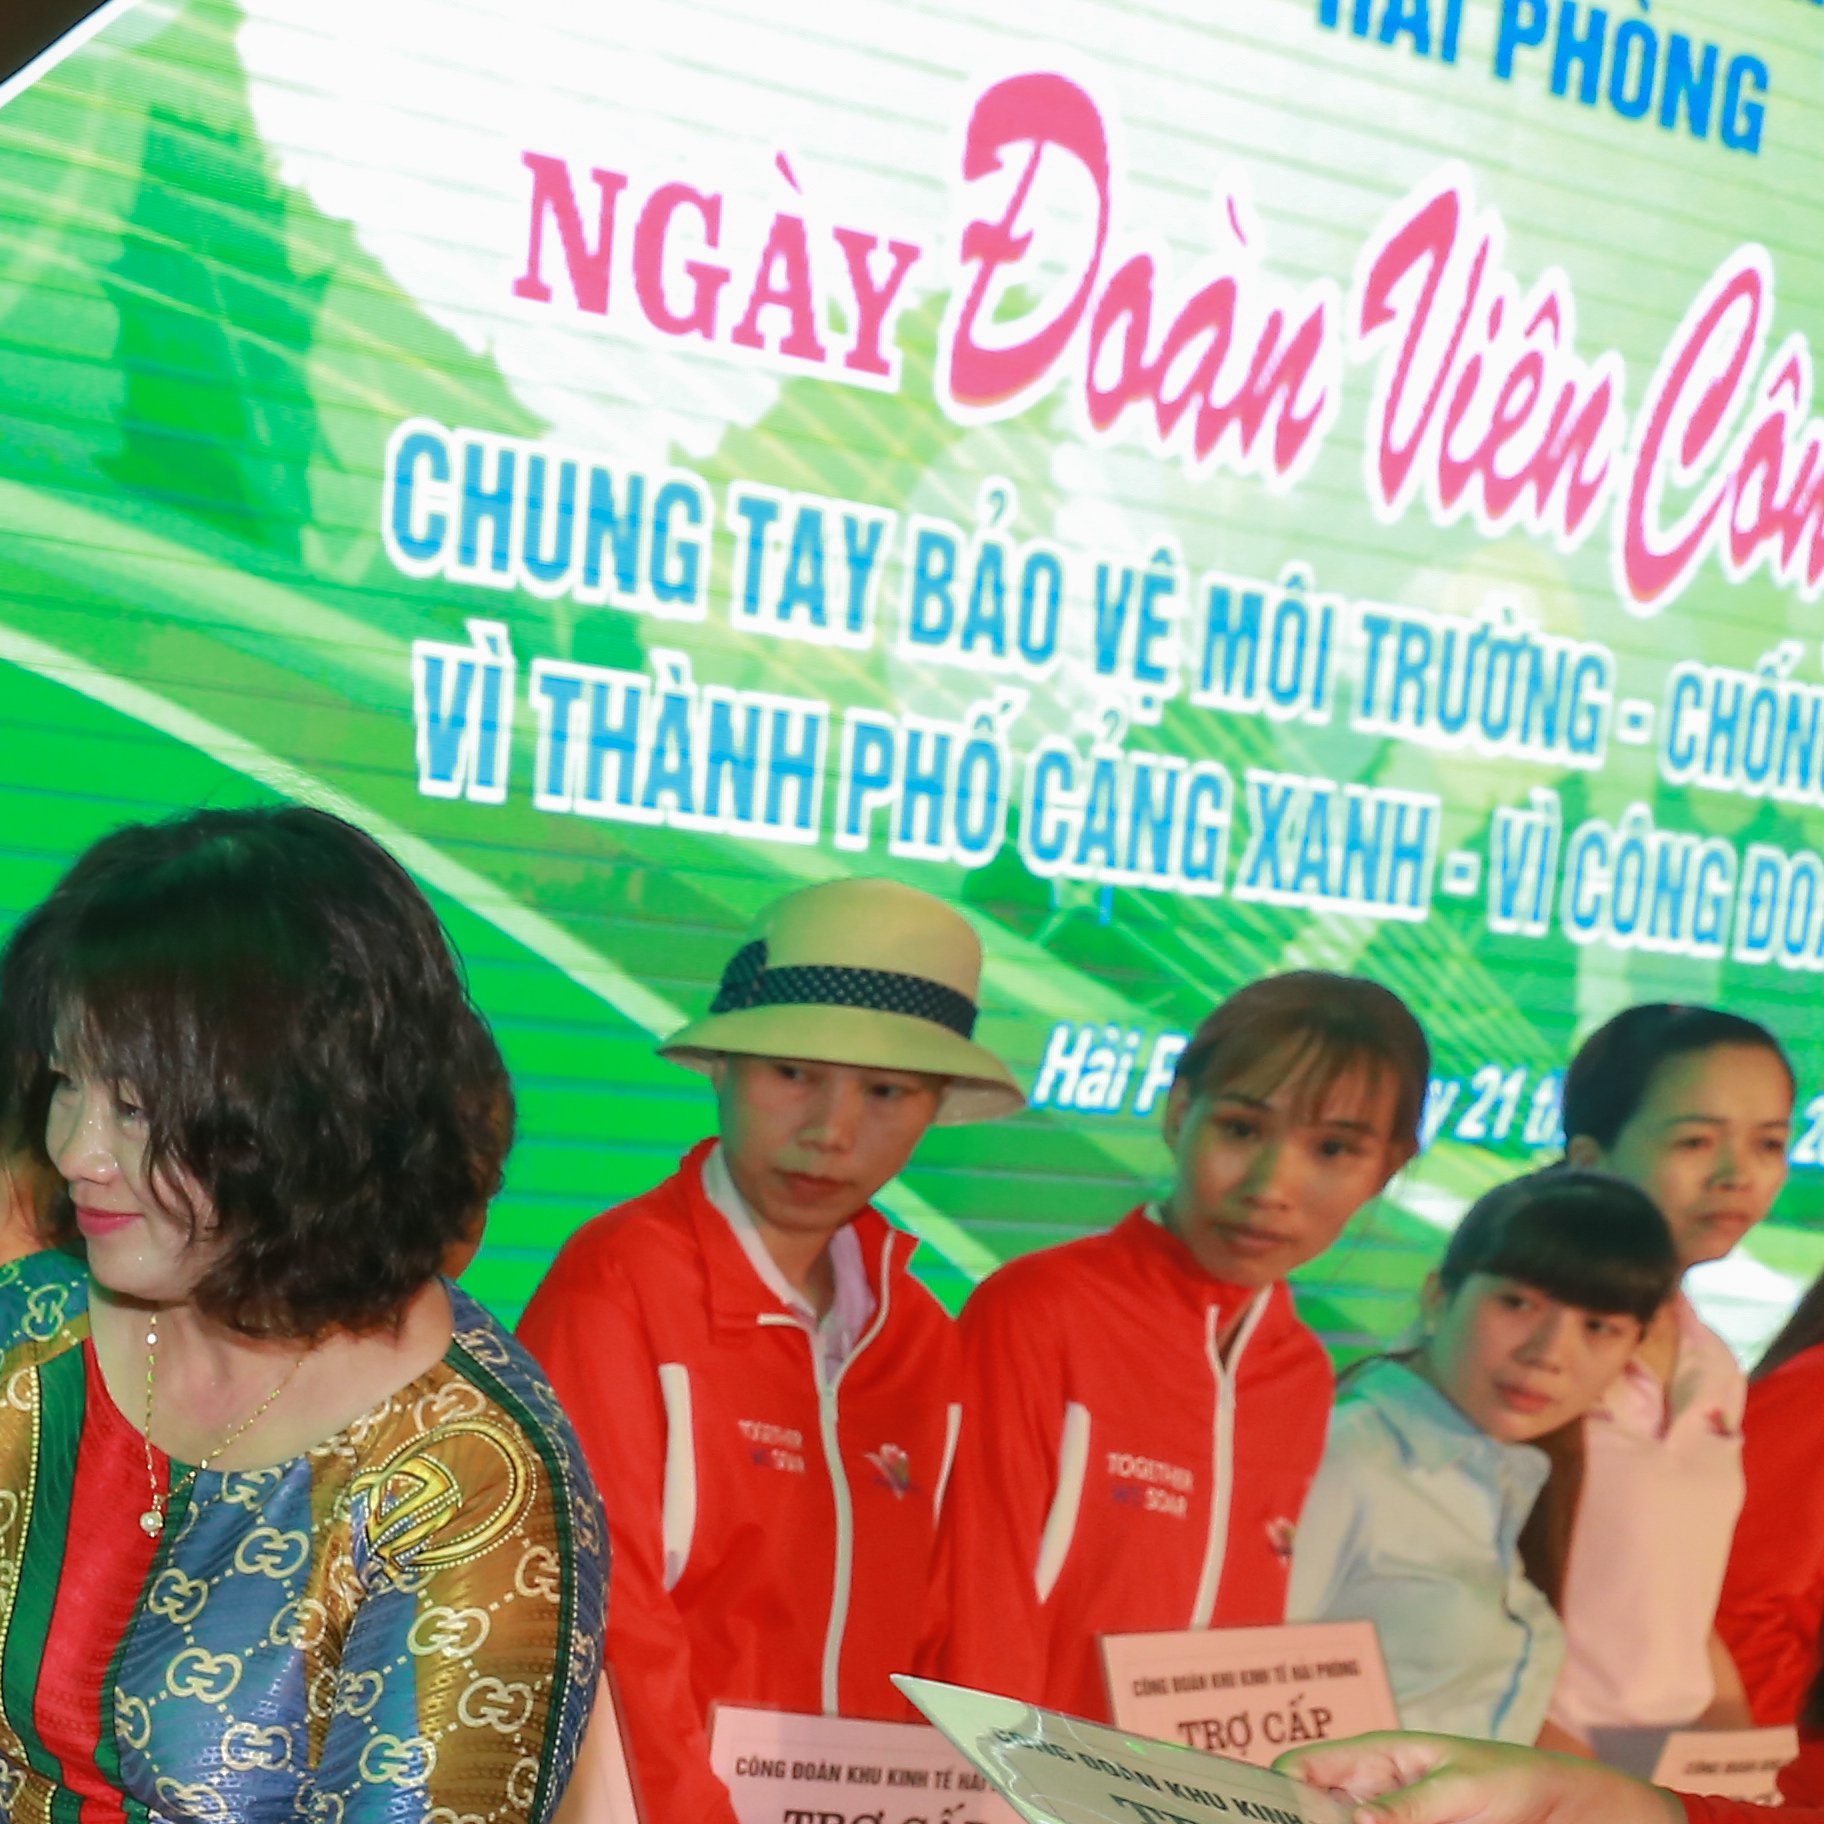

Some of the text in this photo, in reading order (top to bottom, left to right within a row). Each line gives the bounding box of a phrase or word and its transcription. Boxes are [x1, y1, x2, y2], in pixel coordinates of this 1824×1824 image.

[1492, 0, 1770, 157] PHÒNG
[512, 72, 1824, 604] NGÀY Đoàn Viên Côn
[392, 431, 702, 603] CHUNG
[736, 494, 885, 631] TAY
[909, 487, 1062, 663] BẢO
[1093, 548, 1177, 712] VỆ
[1200, 574, 1335, 712] MÔI
[1360, 606, 1608, 755] TRƯỜNG
[1669, 653, 1824, 791] CHỐN
[424, 634, 503, 783] VÌ
[539, 665, 821, 831] THÀNH
[843, 700, 1013, 853] PHỐ
[1027, 709, 1228, 882] CẢNG
[1246, 781, 1436, 911] XANH
[1500, 792, 1553, 924] VÌ
[1570, 813, 1729, 945] CÔNG
[1745, 857, 1824, 957] ĐO
[1454, 1064, 1527, 1139] 21
[736, 1756, 785, 1778] CÔNG
[791, 1758, 841, 1783] ĐOÀN
[847, 1765, 881, 1785] KHU
[887, 1768, 928, 1788] KINH
[935, 1766, 952, 1790] TẾ
[1177, 1692, 1333, 1756] TRỢ CẤP
[1164, 1780, 1228, 1811] KHU
